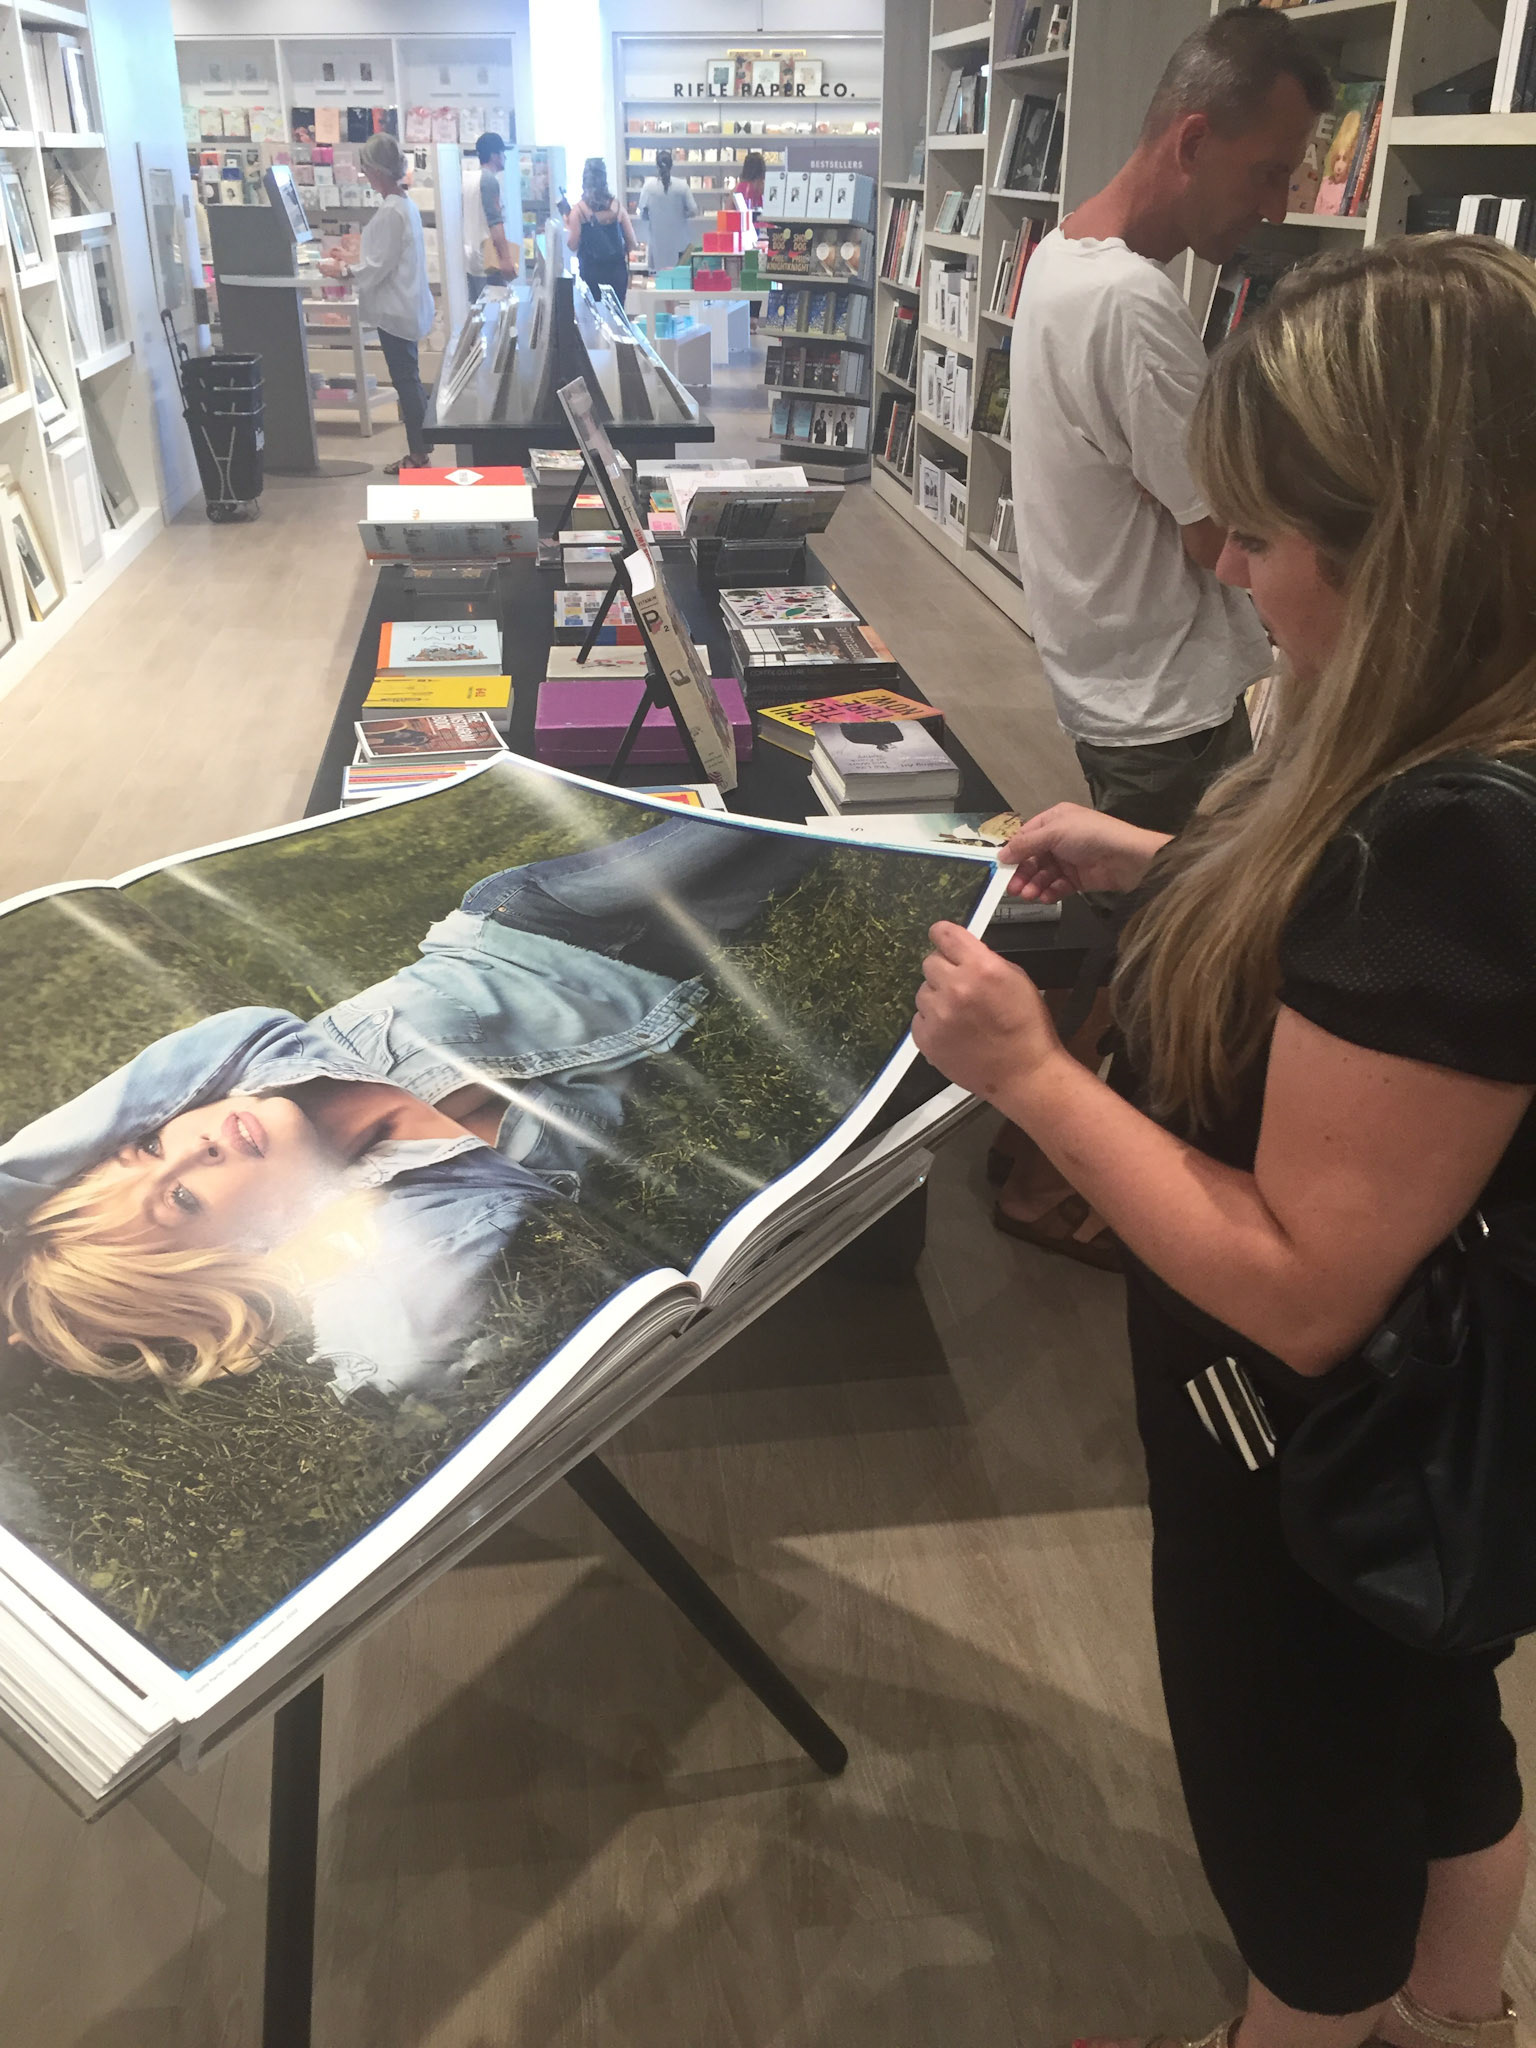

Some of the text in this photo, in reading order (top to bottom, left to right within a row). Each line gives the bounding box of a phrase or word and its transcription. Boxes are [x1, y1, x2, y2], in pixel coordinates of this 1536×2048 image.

[674, 83, 855, 97] RIFLE PAPER CO.
[810, 160, 863, 169] BESTSELLERS
[800, 702, 845, 719] TEC
[837, 699, 893, 721] TURE
[858, 695, 923, 716] NOW!
